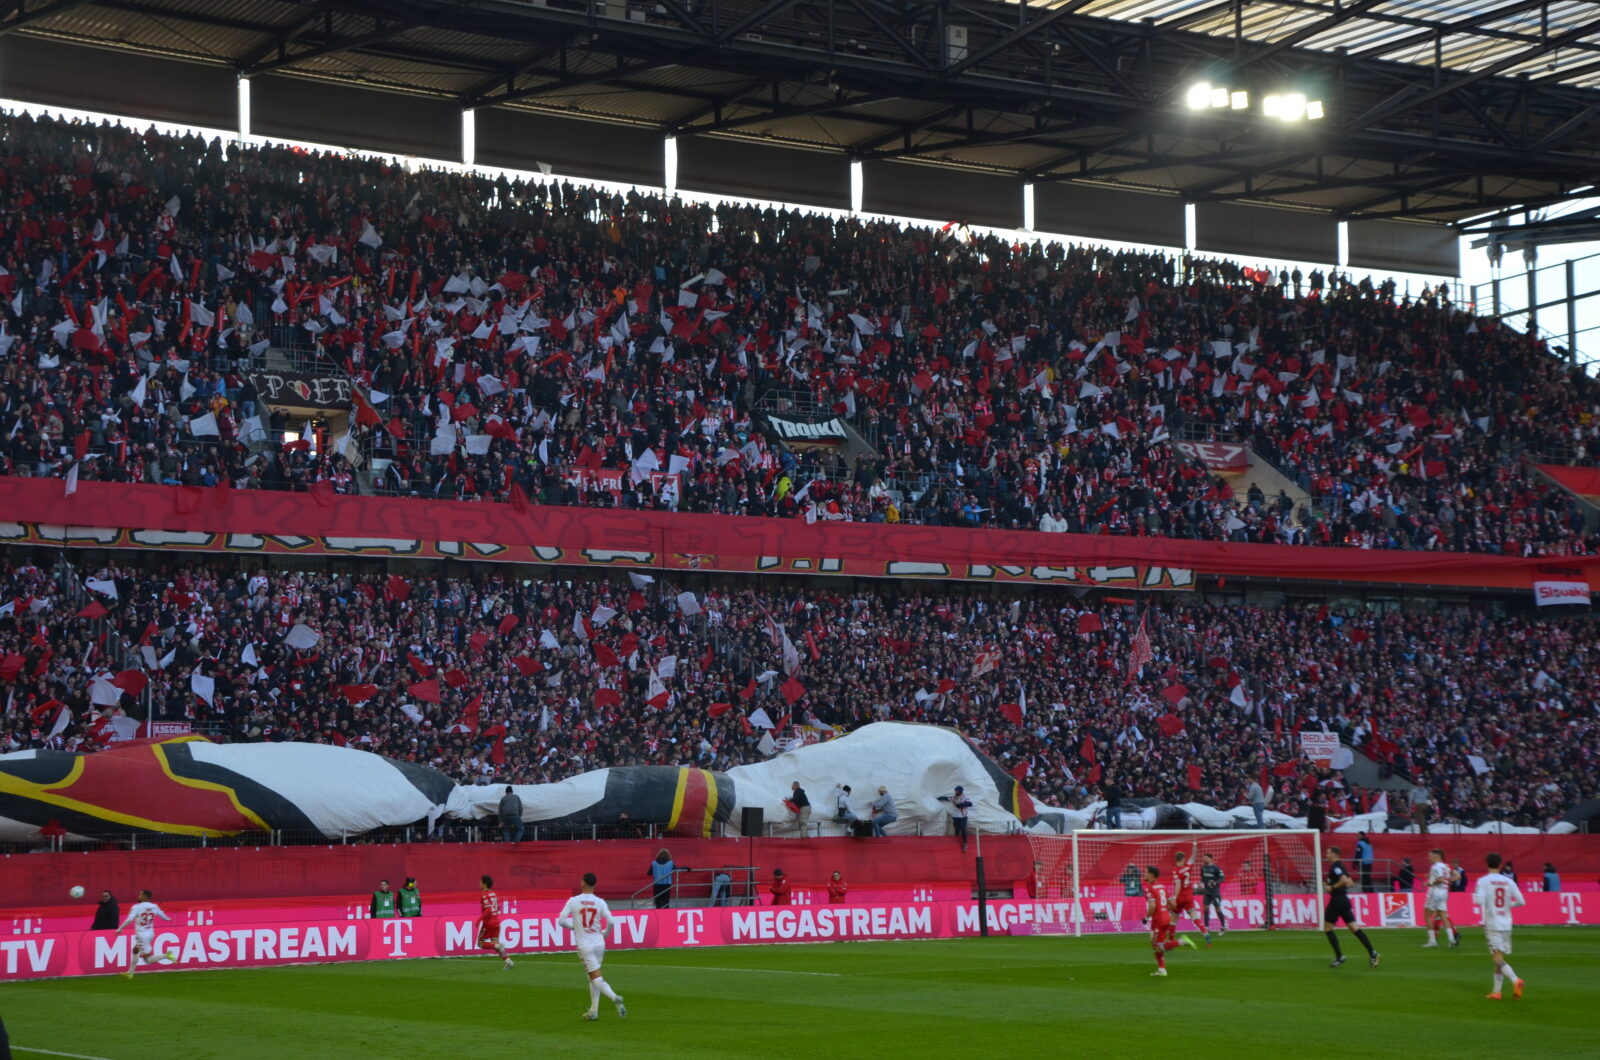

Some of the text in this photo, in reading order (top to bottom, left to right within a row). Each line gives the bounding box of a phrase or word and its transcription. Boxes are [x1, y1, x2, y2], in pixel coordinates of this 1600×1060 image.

[767, 414, 848, 439] TROIKA
[1303, 734, 1337, 743] REDLINE
[1158, 889, 1168, 907] 8
[1494, 887, 1506, 908] 8
[579, 907, 598, 929] 17
[732, 906, 932, 940] MEGASTREAM
[1089, 901, 1123, 923] TV
[612, 914, 648, 945] TV
[0, 939, 55, 974] TV
